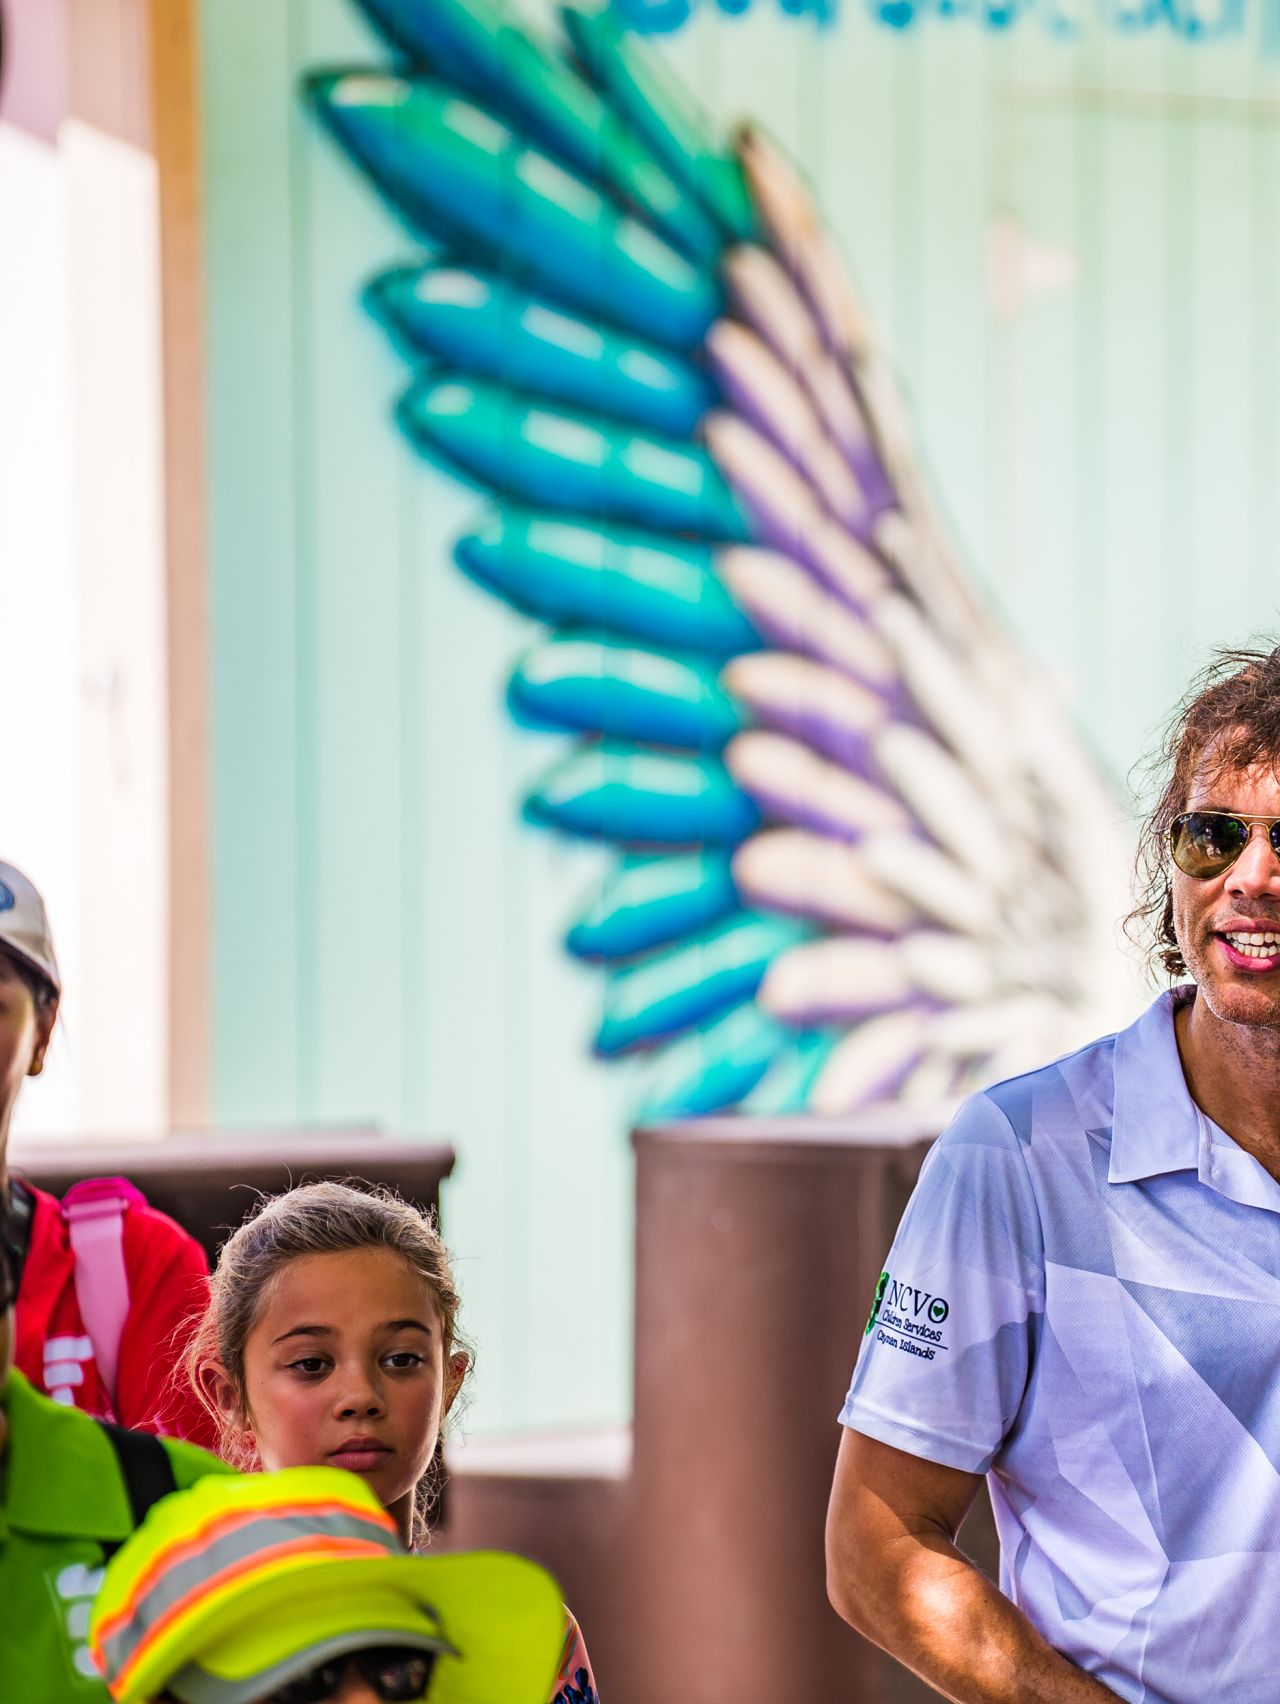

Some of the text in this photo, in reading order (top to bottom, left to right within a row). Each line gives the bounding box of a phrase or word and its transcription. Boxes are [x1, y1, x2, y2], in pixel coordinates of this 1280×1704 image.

[887, 1280, 949, 1324] NCVO
[903, 1318, 943, 1342] Services
[899, 1339, 936, 1360] Islands
